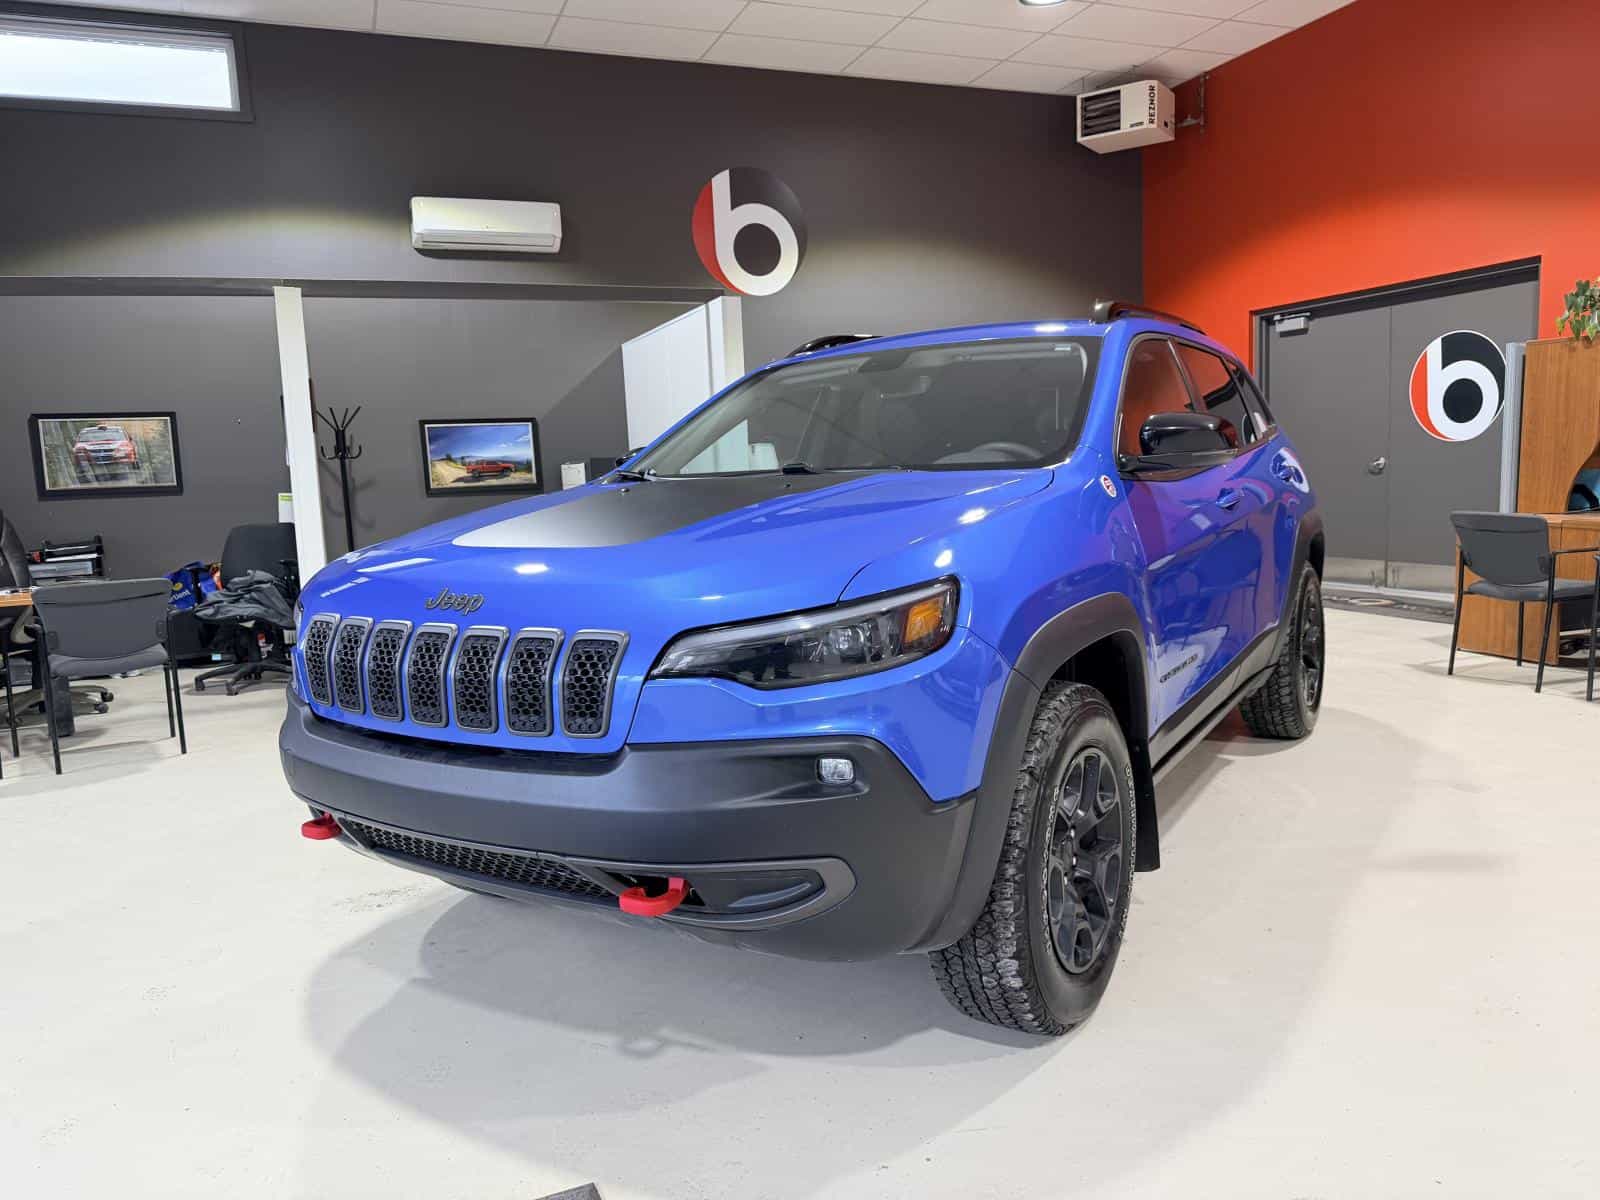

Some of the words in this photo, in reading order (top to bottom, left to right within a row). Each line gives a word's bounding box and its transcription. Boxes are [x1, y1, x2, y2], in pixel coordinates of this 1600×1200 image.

[1148, 85, 1156, 125] REZNOR
[711, 168, 799, 296] b
[424, 587, 484, 616] Jeep
